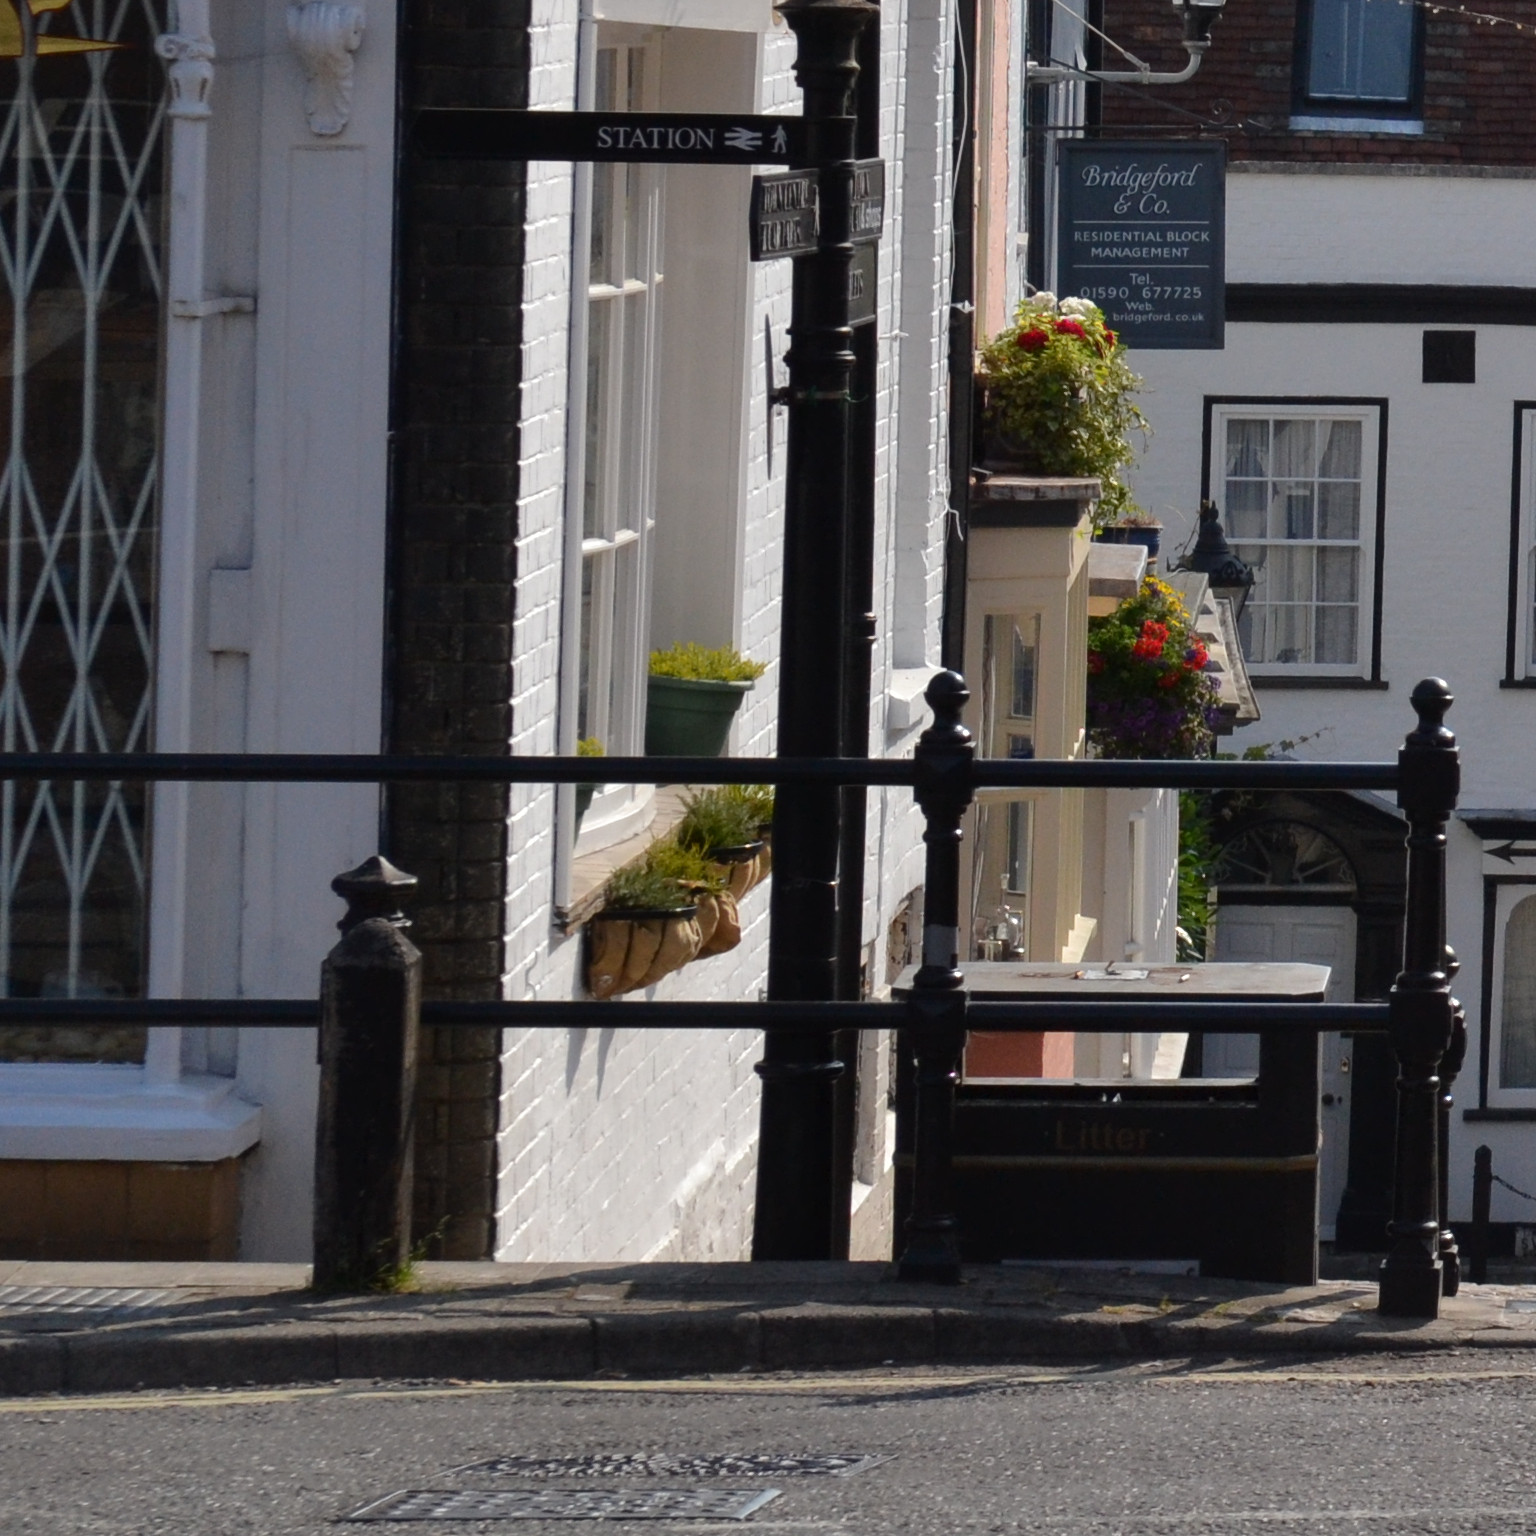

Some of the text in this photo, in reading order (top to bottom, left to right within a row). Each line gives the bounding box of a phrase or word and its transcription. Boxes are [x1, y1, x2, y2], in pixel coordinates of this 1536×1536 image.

[598, 126, 716, 150] STATION
[1081, 163, 1203, 195] Bridgeford
[1114, 193, 1171, 214] & Co.
[1074, 231, 1210, 242] RESIDENTIAL BLOCK
[1091, 247, 1189, 258] MANAGEMENT
[1129, 273, 1154, 285] Tel.
[1080, 287, 1202, 299] 01590 677725
[1125, 301, 1155, 311] Web.
[1056, 1119, 1151, 1151] Litter
